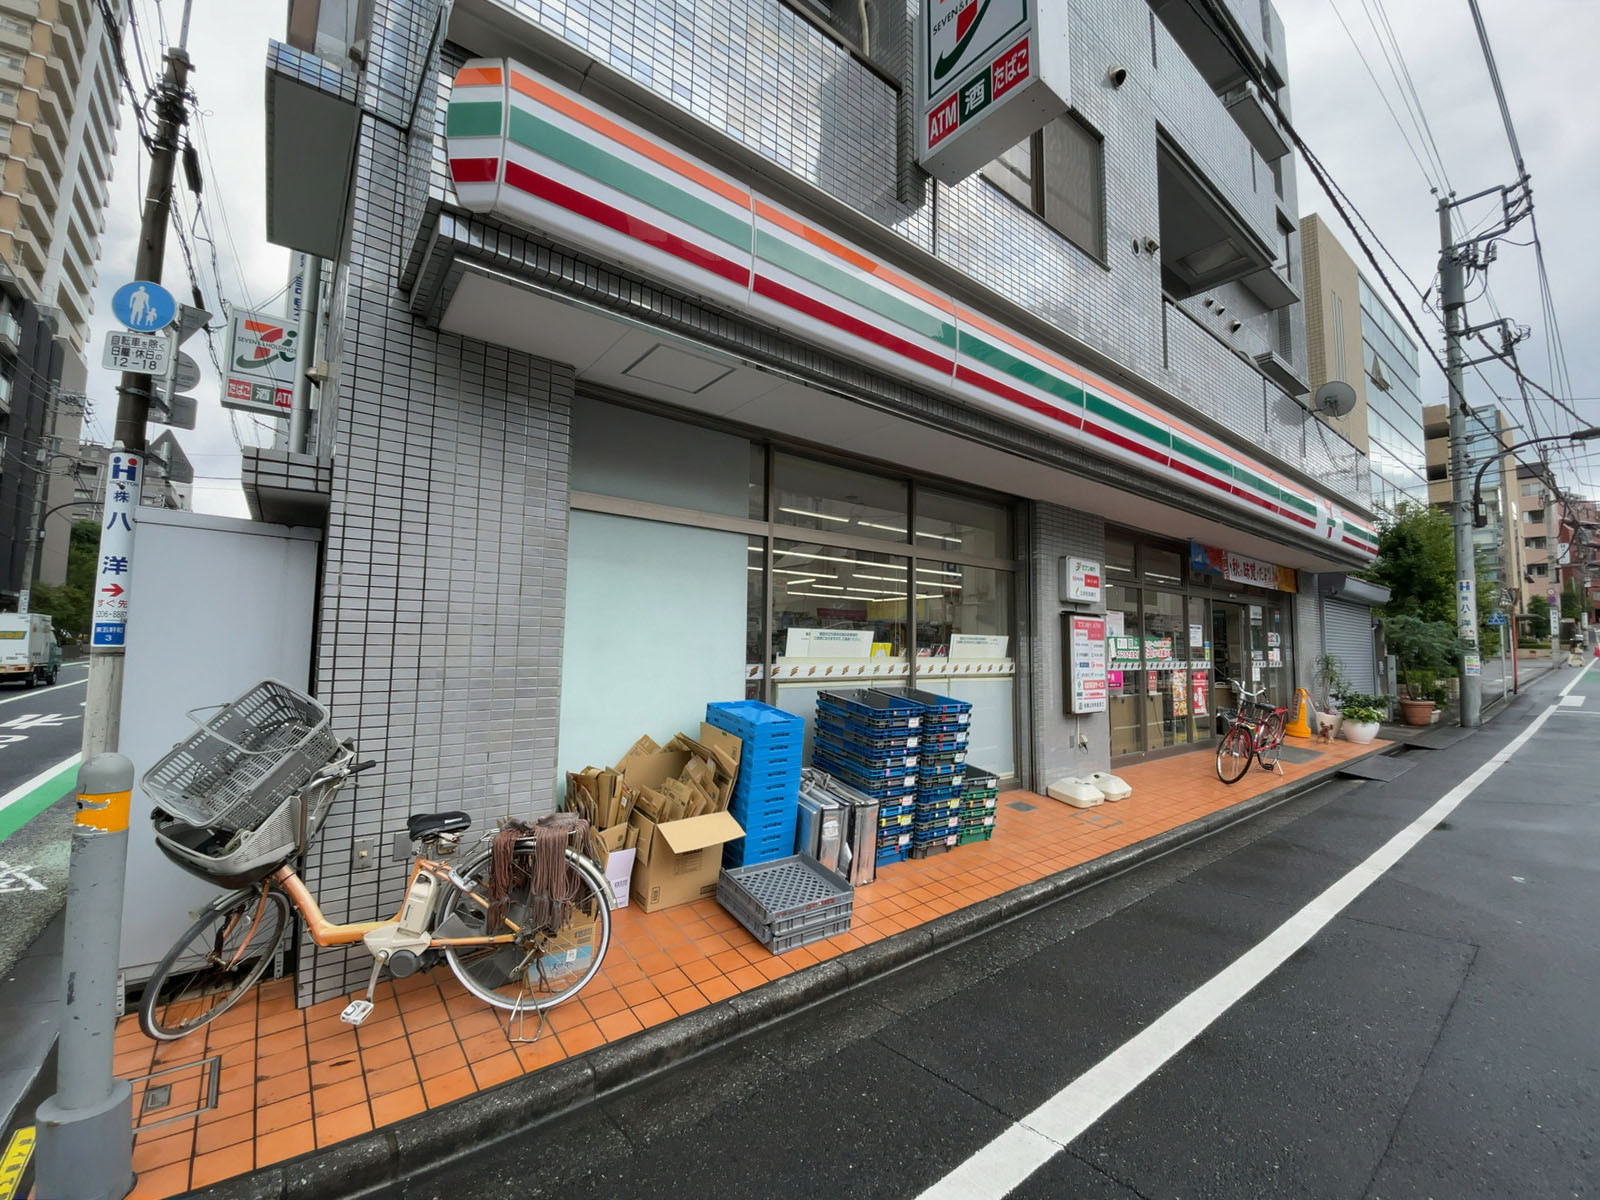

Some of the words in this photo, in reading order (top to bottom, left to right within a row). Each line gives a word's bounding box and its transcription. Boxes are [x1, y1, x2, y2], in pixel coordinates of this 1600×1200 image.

[993, 48, 1029, 93] たばこ
[964, 78, 986, 116] 酒
[930, 101, 957, 142] ATM
[110, 335, 165, 350] 自転車を除く
[228, 382, 251, 398] たばこ
[255, 386, 272, 402] 酒
[97, 599, 128, 609] すぐ先
[104, 633, 113, 642] 3
